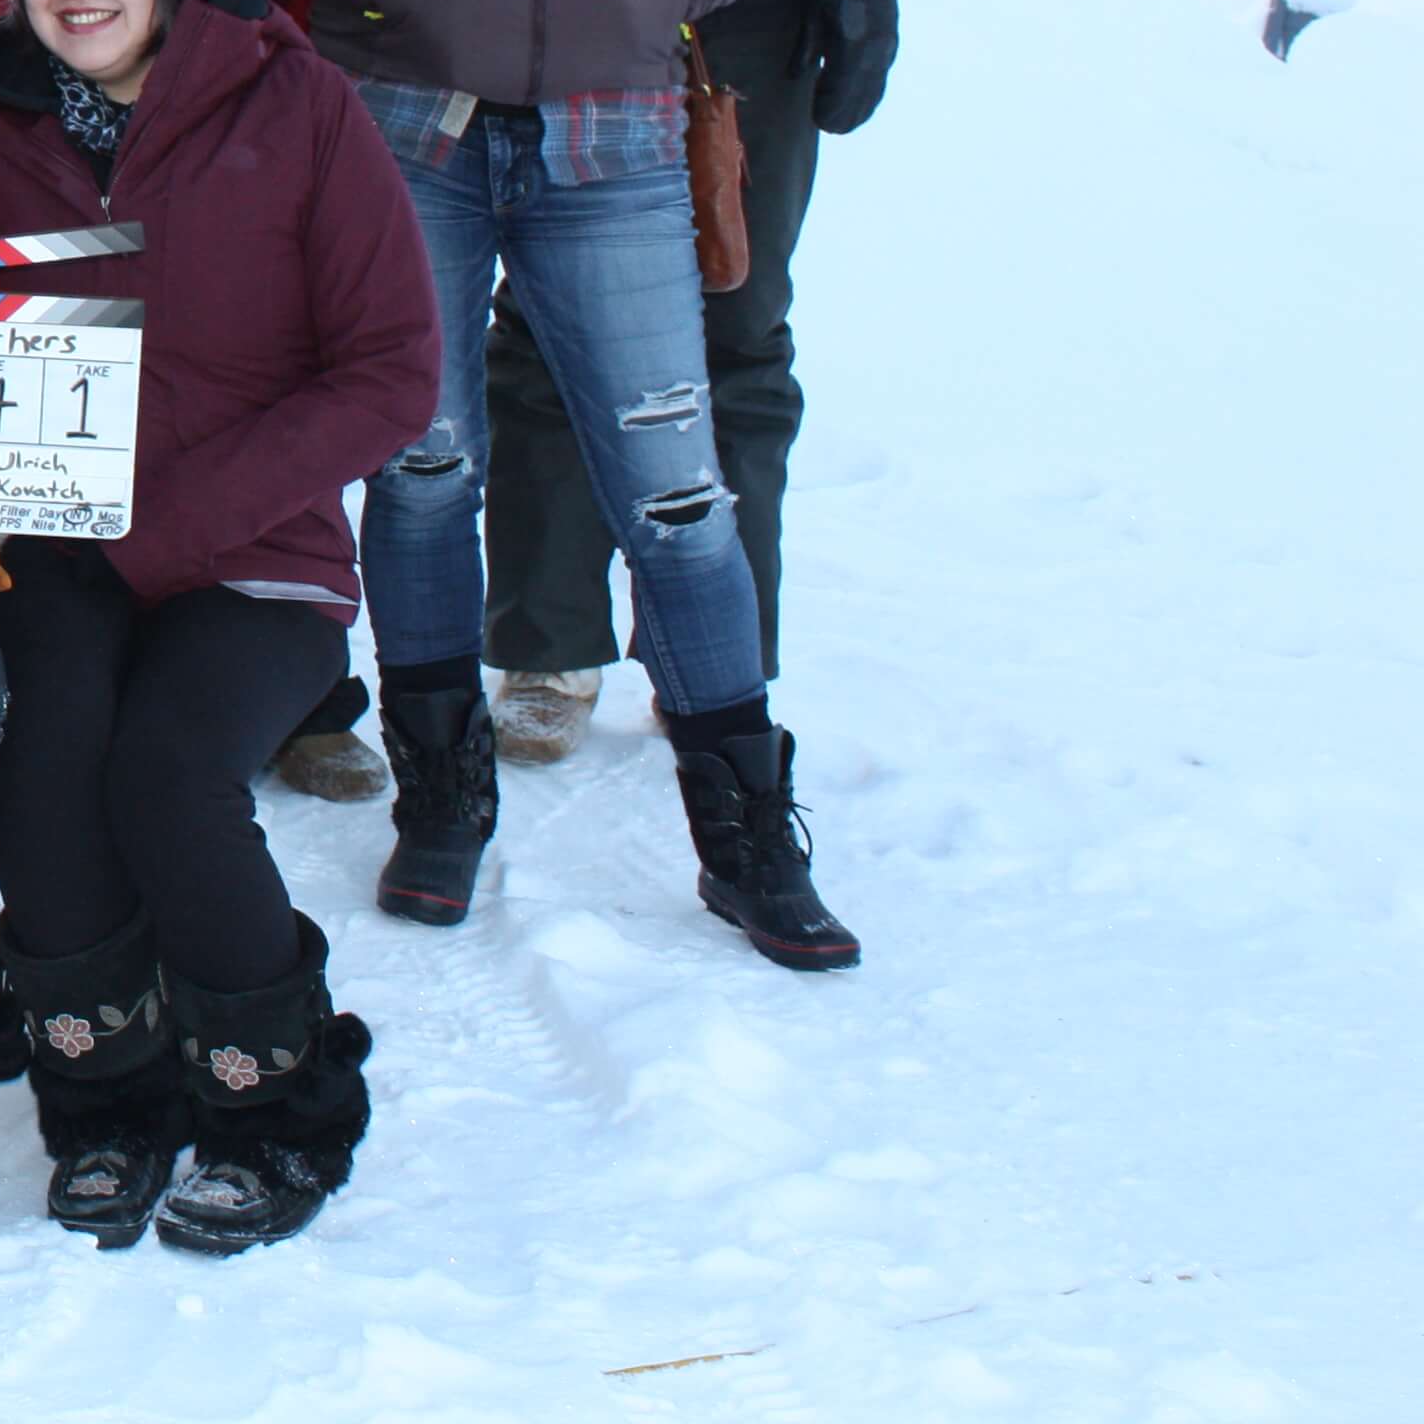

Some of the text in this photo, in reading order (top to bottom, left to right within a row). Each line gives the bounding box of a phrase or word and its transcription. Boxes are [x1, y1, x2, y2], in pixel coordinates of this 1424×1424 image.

[75, 364, 111, 378] TAKE
[65, 377, 98, 440] 1
[0, 504, 31, 517] Filter
[38, 506, 63, 520] Day
[0, 517, 22, 529] FPS
